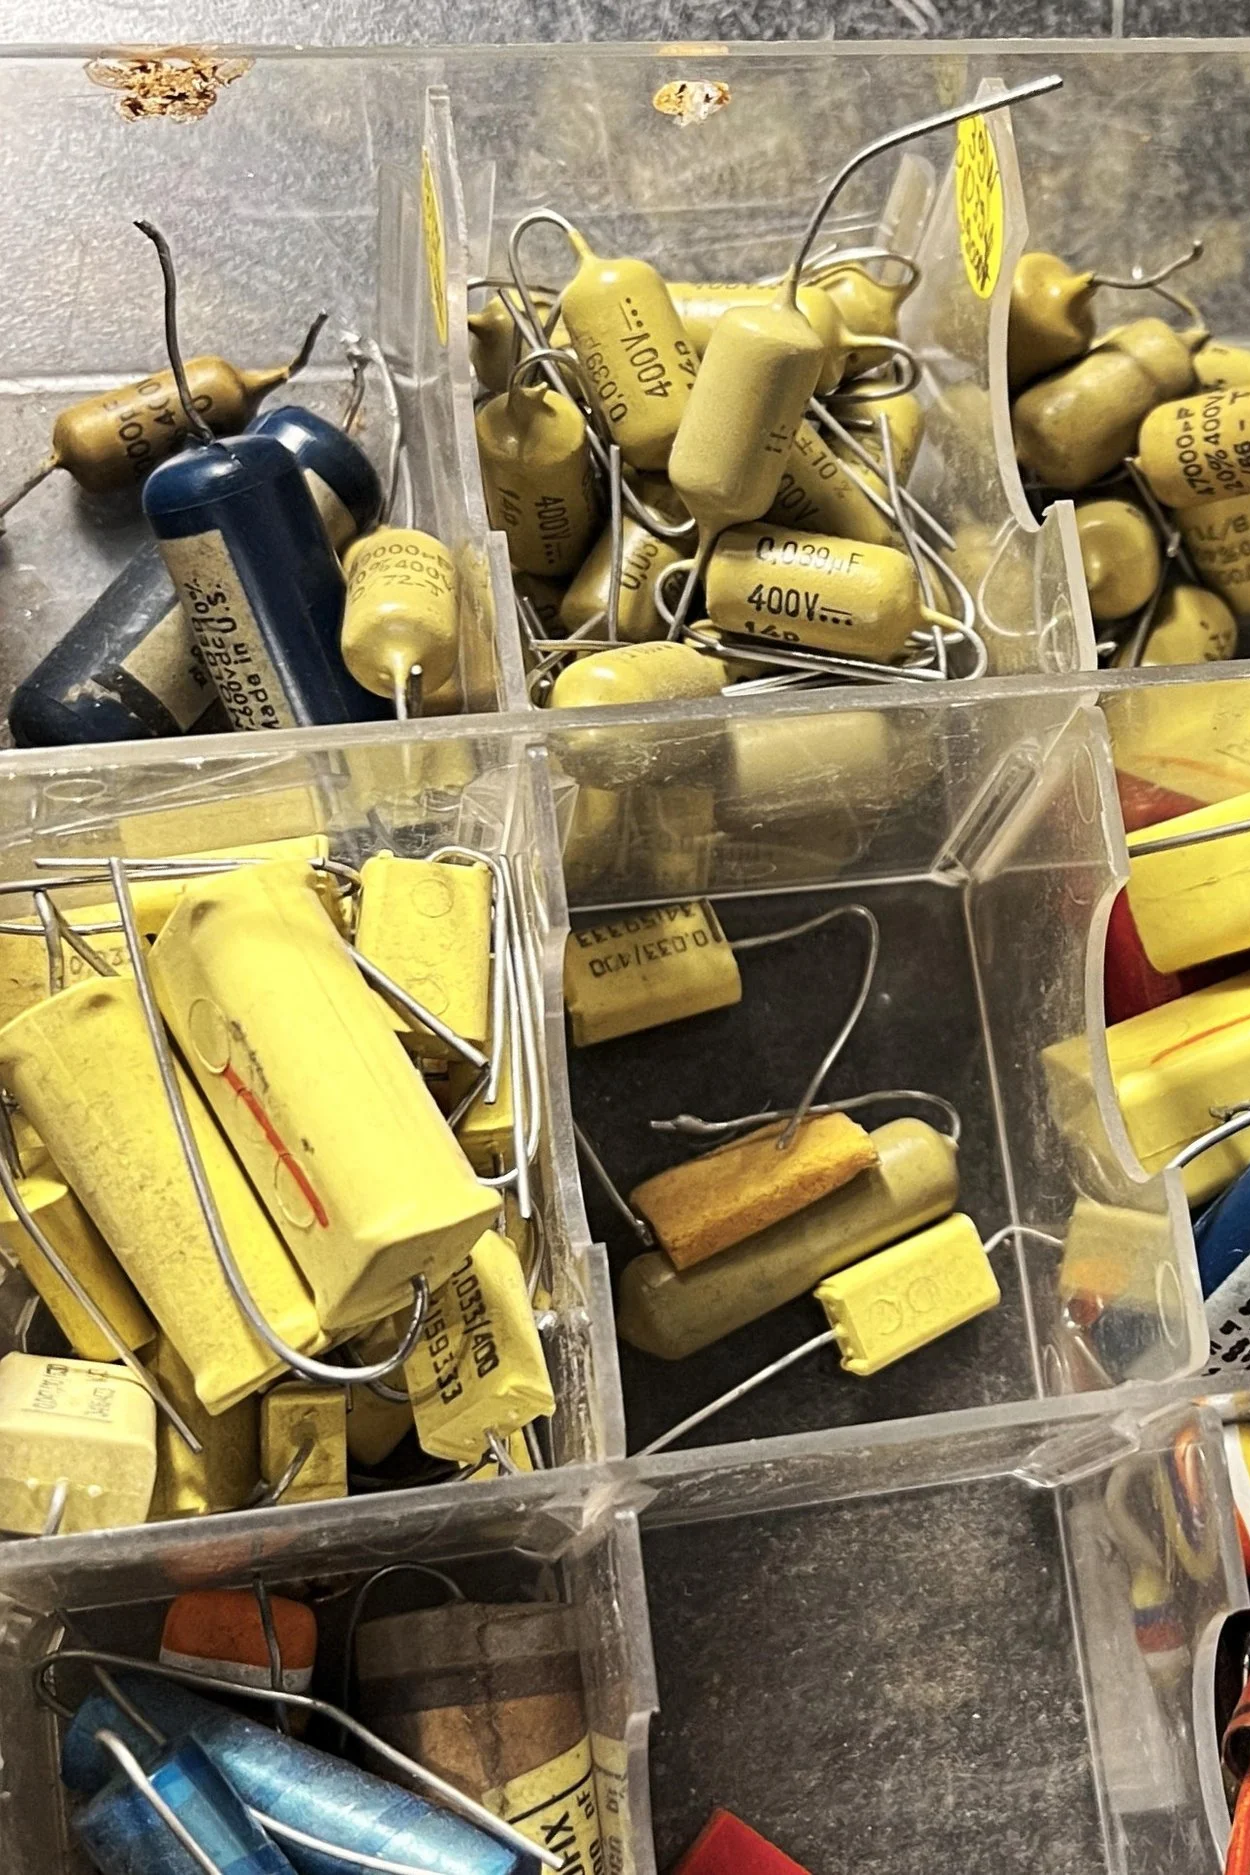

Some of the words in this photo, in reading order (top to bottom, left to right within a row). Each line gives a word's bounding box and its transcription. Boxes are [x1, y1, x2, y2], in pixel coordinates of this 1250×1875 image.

[619, 329, 676, 398] 400V
[1206, 451, 1244, 489] 20%
[780, 474, 820, 521] 00V
[757, 537, 863, 574] 0,039µF
[747, 584, 819, 621] 400V
[233, 642, 252, 664] in
[423, 1297, 464, 1405] 159333
